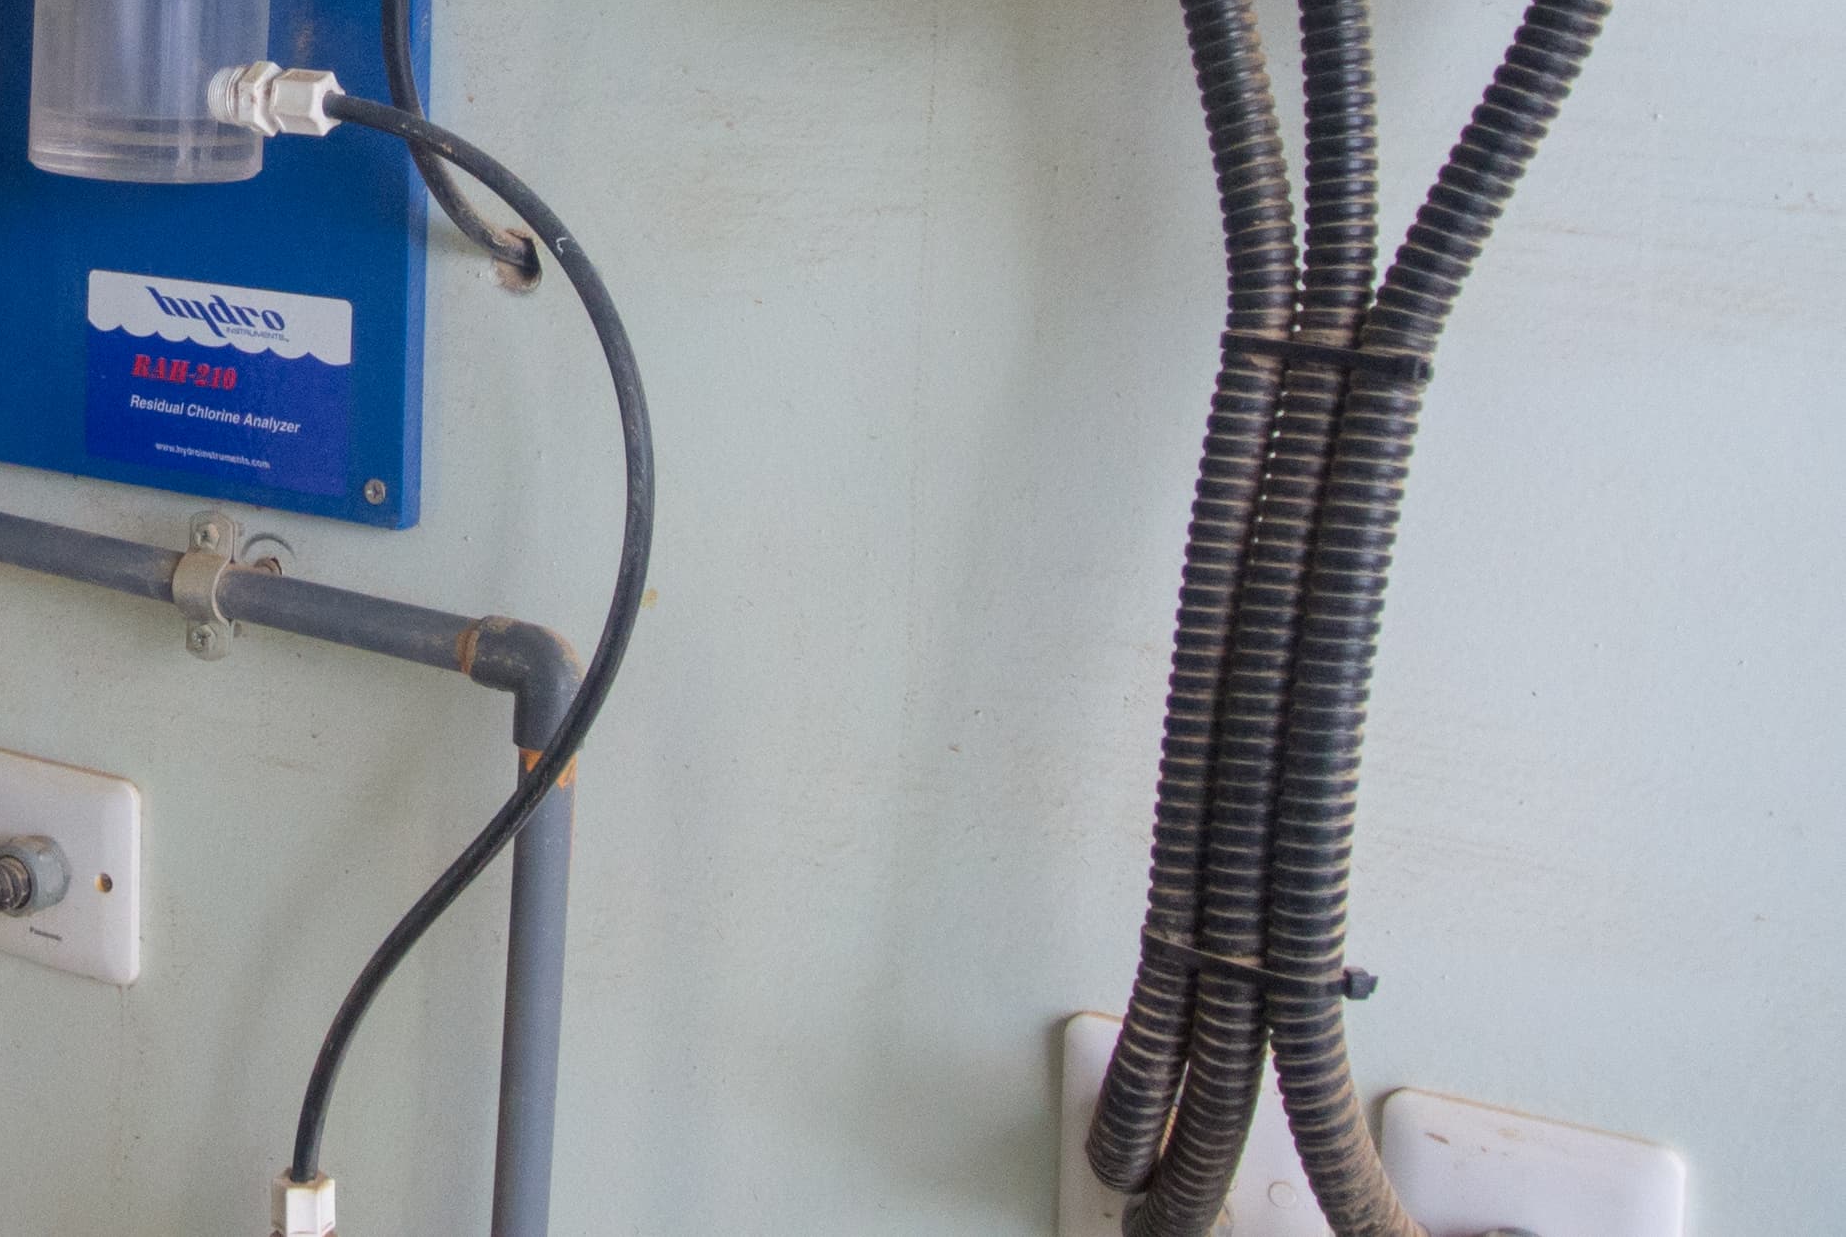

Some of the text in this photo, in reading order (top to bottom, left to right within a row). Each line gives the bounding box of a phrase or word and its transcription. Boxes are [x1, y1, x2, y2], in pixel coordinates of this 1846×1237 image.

[145, 285, 286, 338] hydro
[131, 353, 238, 391] RAH-210
[130, 394, 302, 434] Residual Chlorine Analyzer
[155, 442, 271, 469] www.hydroinstruments.com
